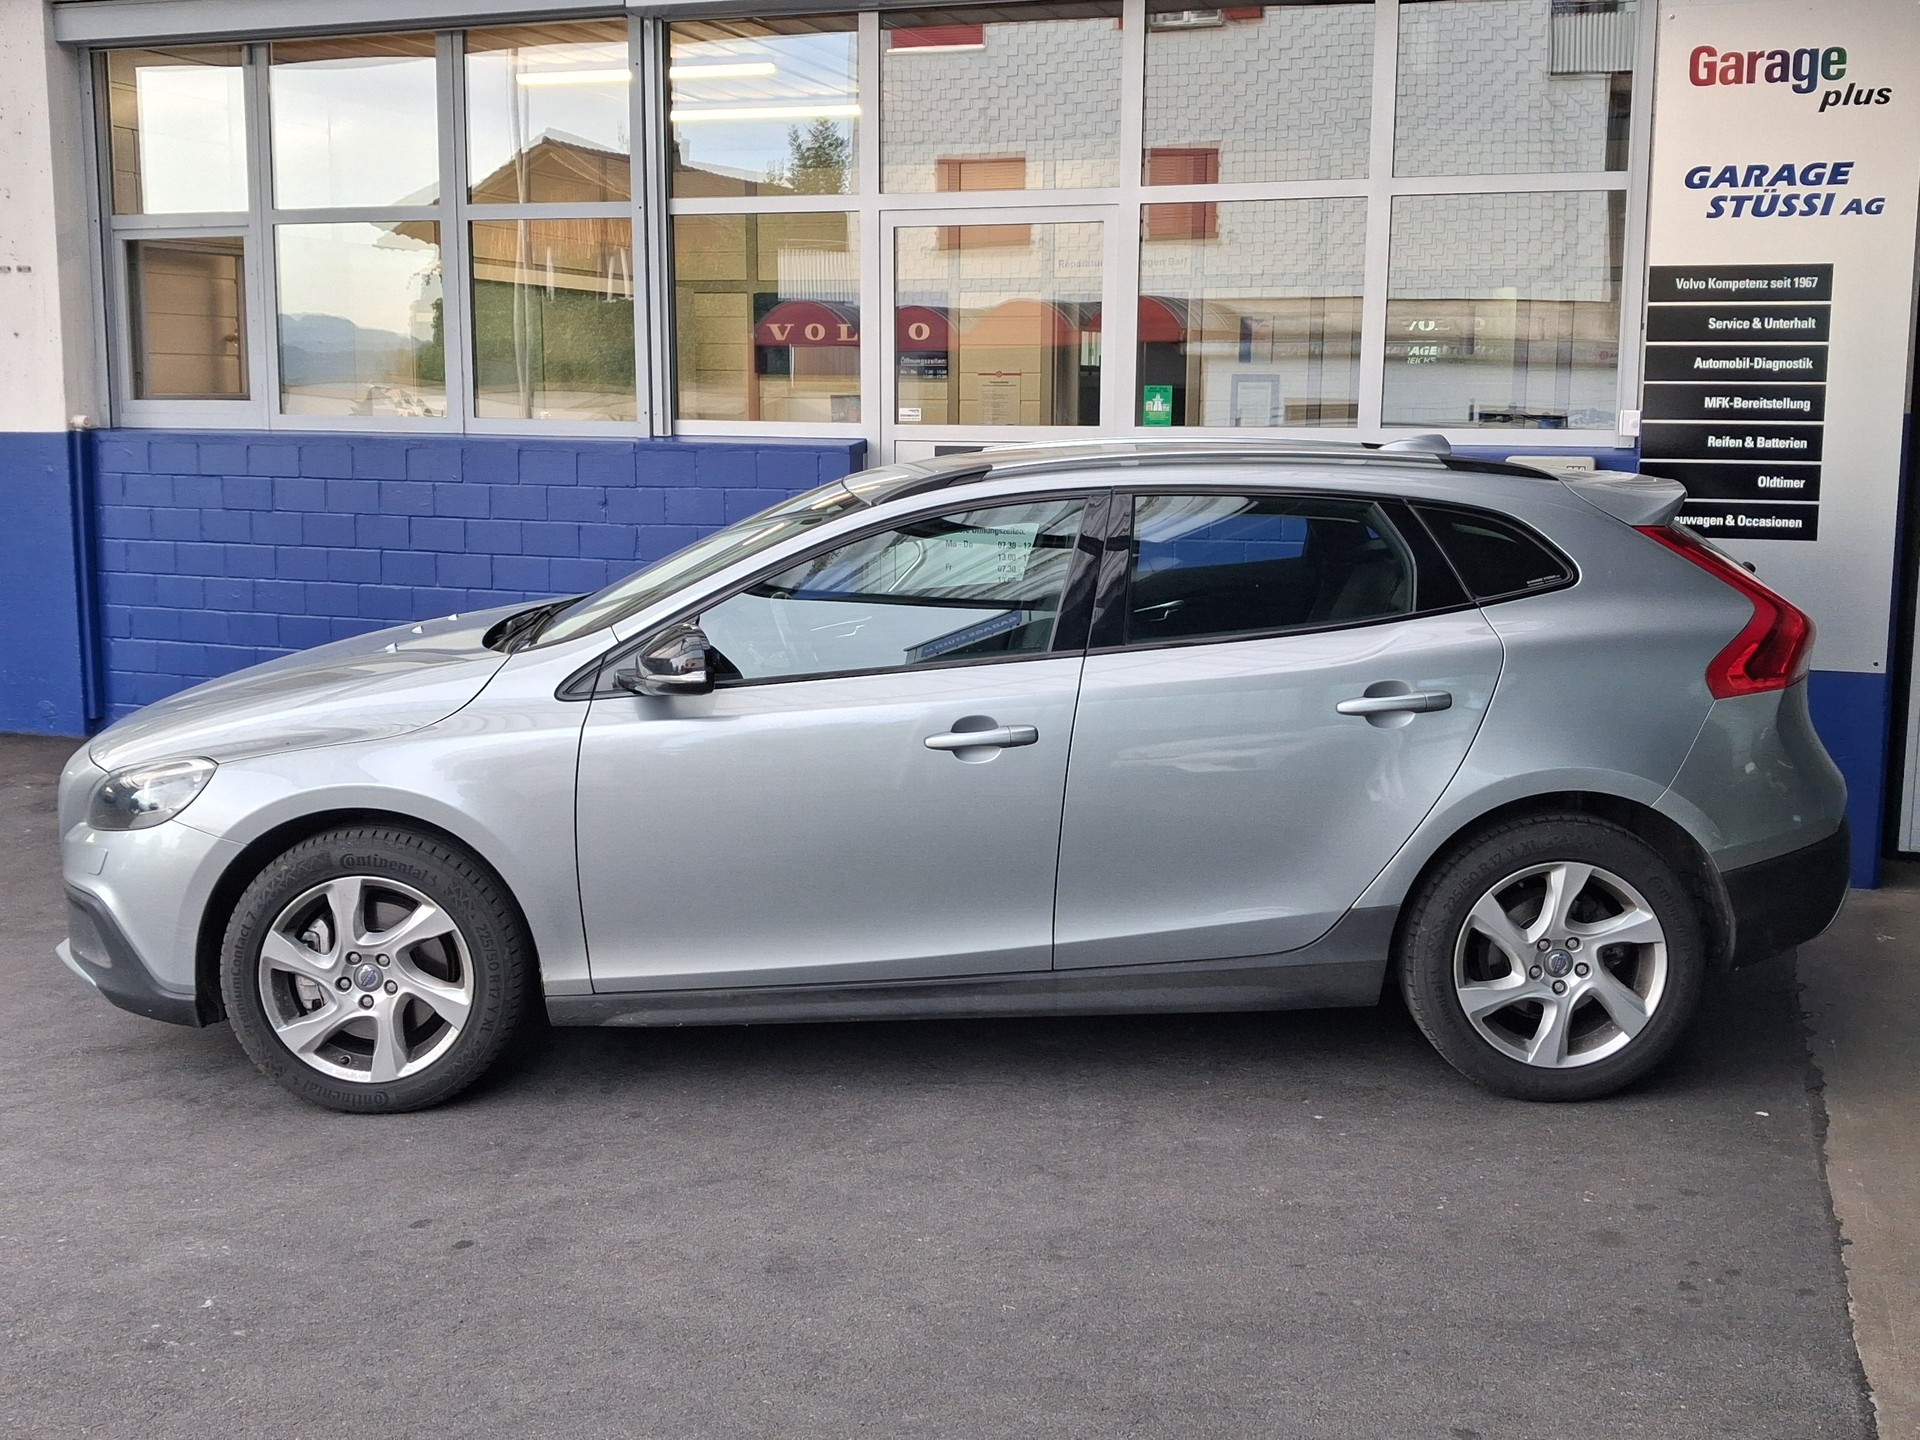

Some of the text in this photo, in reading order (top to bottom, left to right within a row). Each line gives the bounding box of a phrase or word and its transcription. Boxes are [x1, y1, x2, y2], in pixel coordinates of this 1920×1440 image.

[1689, 45, 1848, 94] Garage
[1818, 82, 1893, 113] plus
[1684, 161, 1855, 190] GARAGE
[1706, 188, 1886, 219] STÜSSI AG
[1675, 277, 1819, 292] Volvo Kompetenz seit 1967
[1708, 317, 1816, 330] Service & Unterhalt
[1693, 357, 1814, 371] Automobil-Diagnostik
[1704, 397, 1811, 411] MFK-Bereitstellung
[1707, 436, 1808, 450] Reifen & Batterien
[1757, 475, 1806, 489] Oldtimer
[1674, 514, 1803, 528] euwagen & Occasionen
[339, 853, 428, 881] Continental
